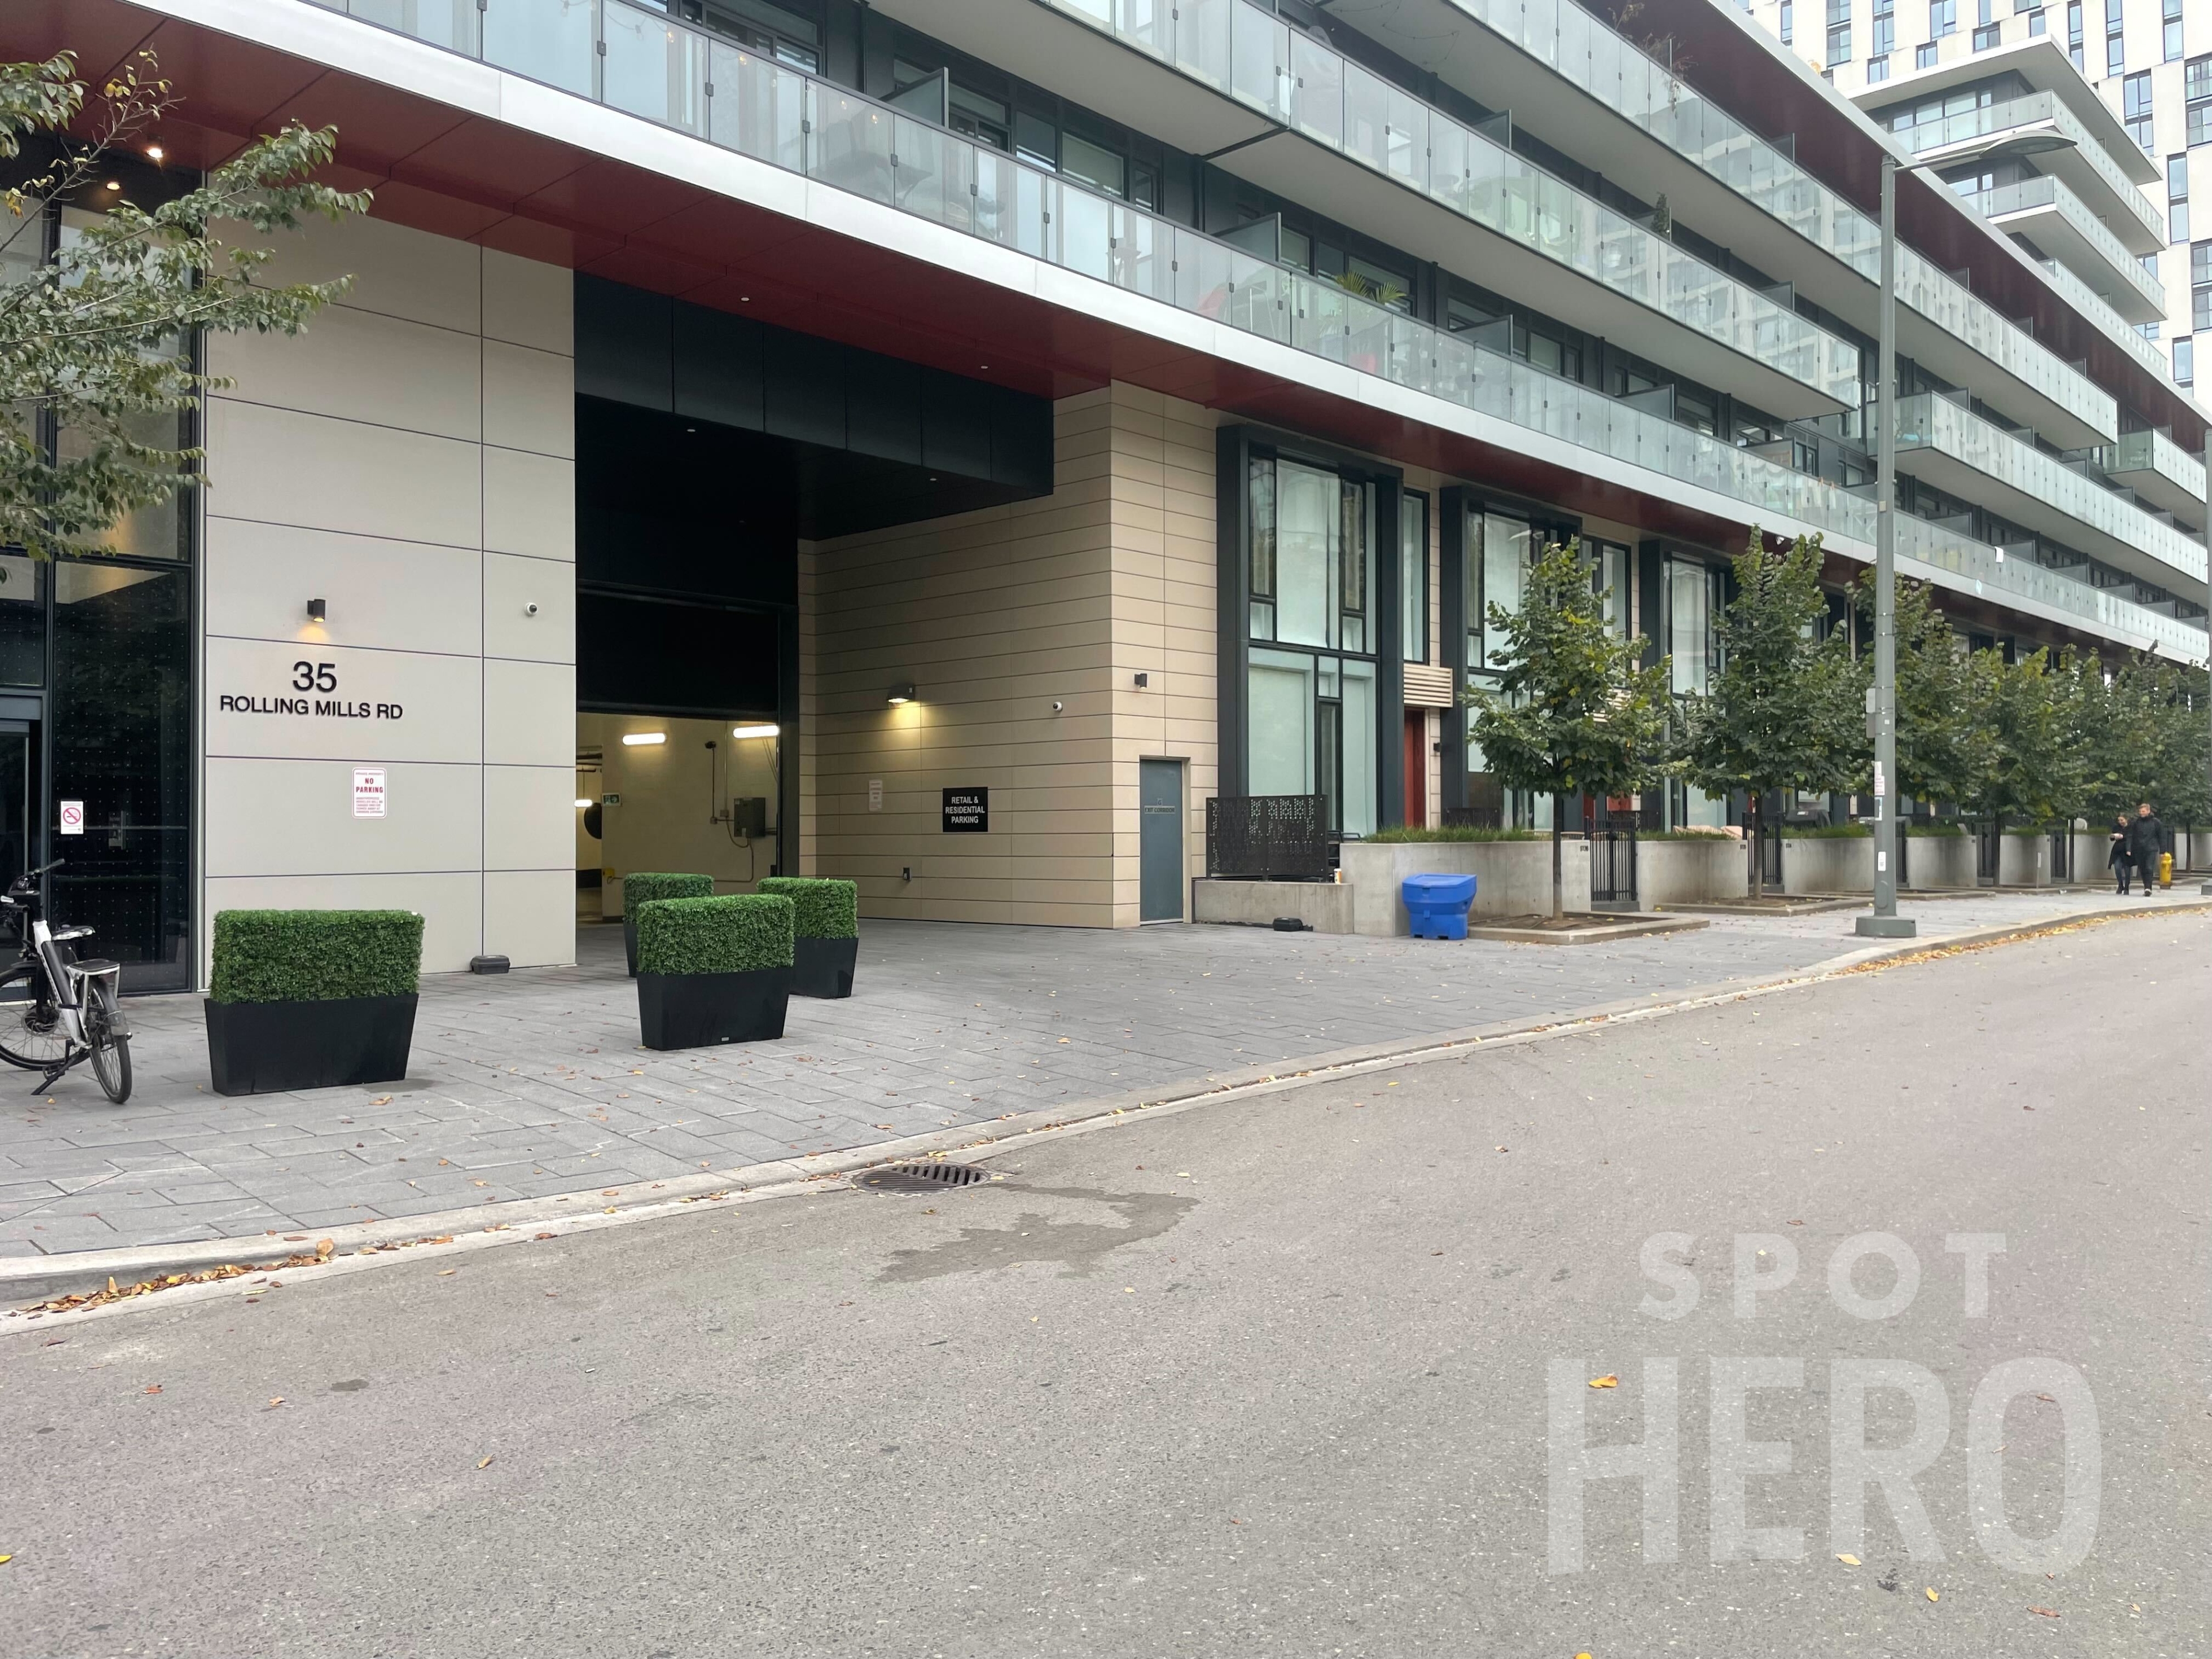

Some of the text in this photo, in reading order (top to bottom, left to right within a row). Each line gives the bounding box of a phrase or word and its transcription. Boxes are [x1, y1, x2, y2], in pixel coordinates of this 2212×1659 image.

[293, 661, 337, 693] 35
[220, 695, 403, 719] ROLLING MILLS RD
[951, 796, 979, 804] RETAIL &
[945, 806, 985, 814] RESIDENTIAL
[951, 816, 979, 824] PARKING
